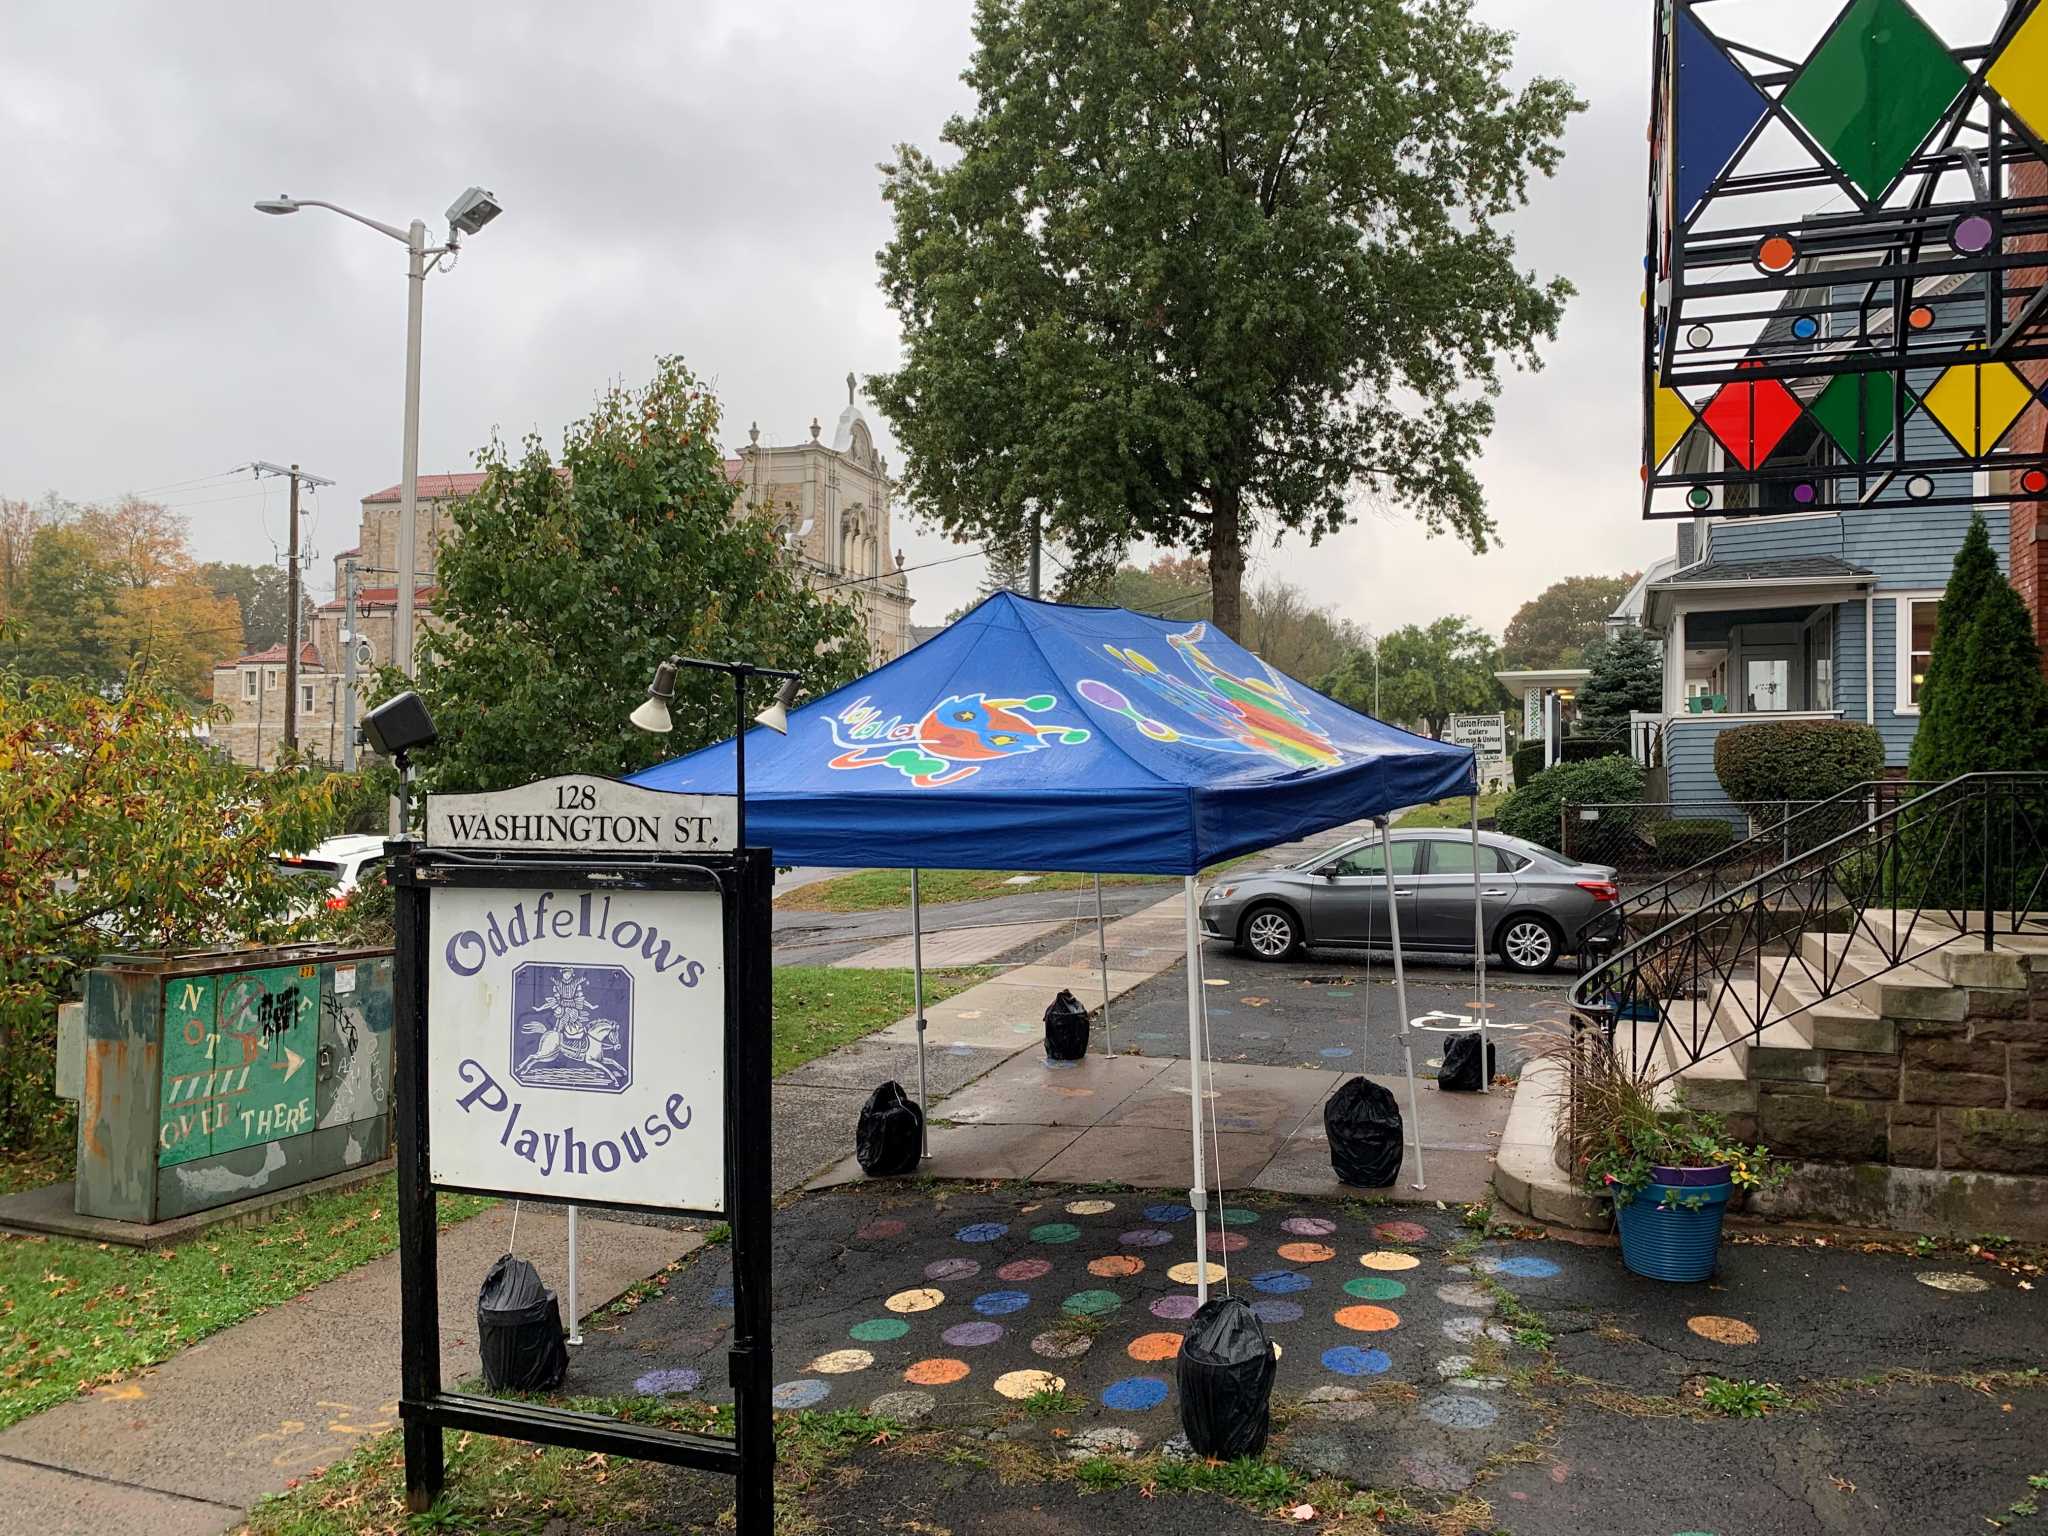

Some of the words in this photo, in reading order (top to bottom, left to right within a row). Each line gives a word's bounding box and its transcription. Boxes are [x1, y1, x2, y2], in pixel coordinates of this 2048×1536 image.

[555, 785, 596, 811] 128
[447, 814, 661, 844] WASHINGTON
[673, 816, 719, 845] ST.
[445, 891, 705, 989] Oddfellows
[240, 1097, 312, 1140] THERE
[455, 1058, 693, 1178] Playhouse
